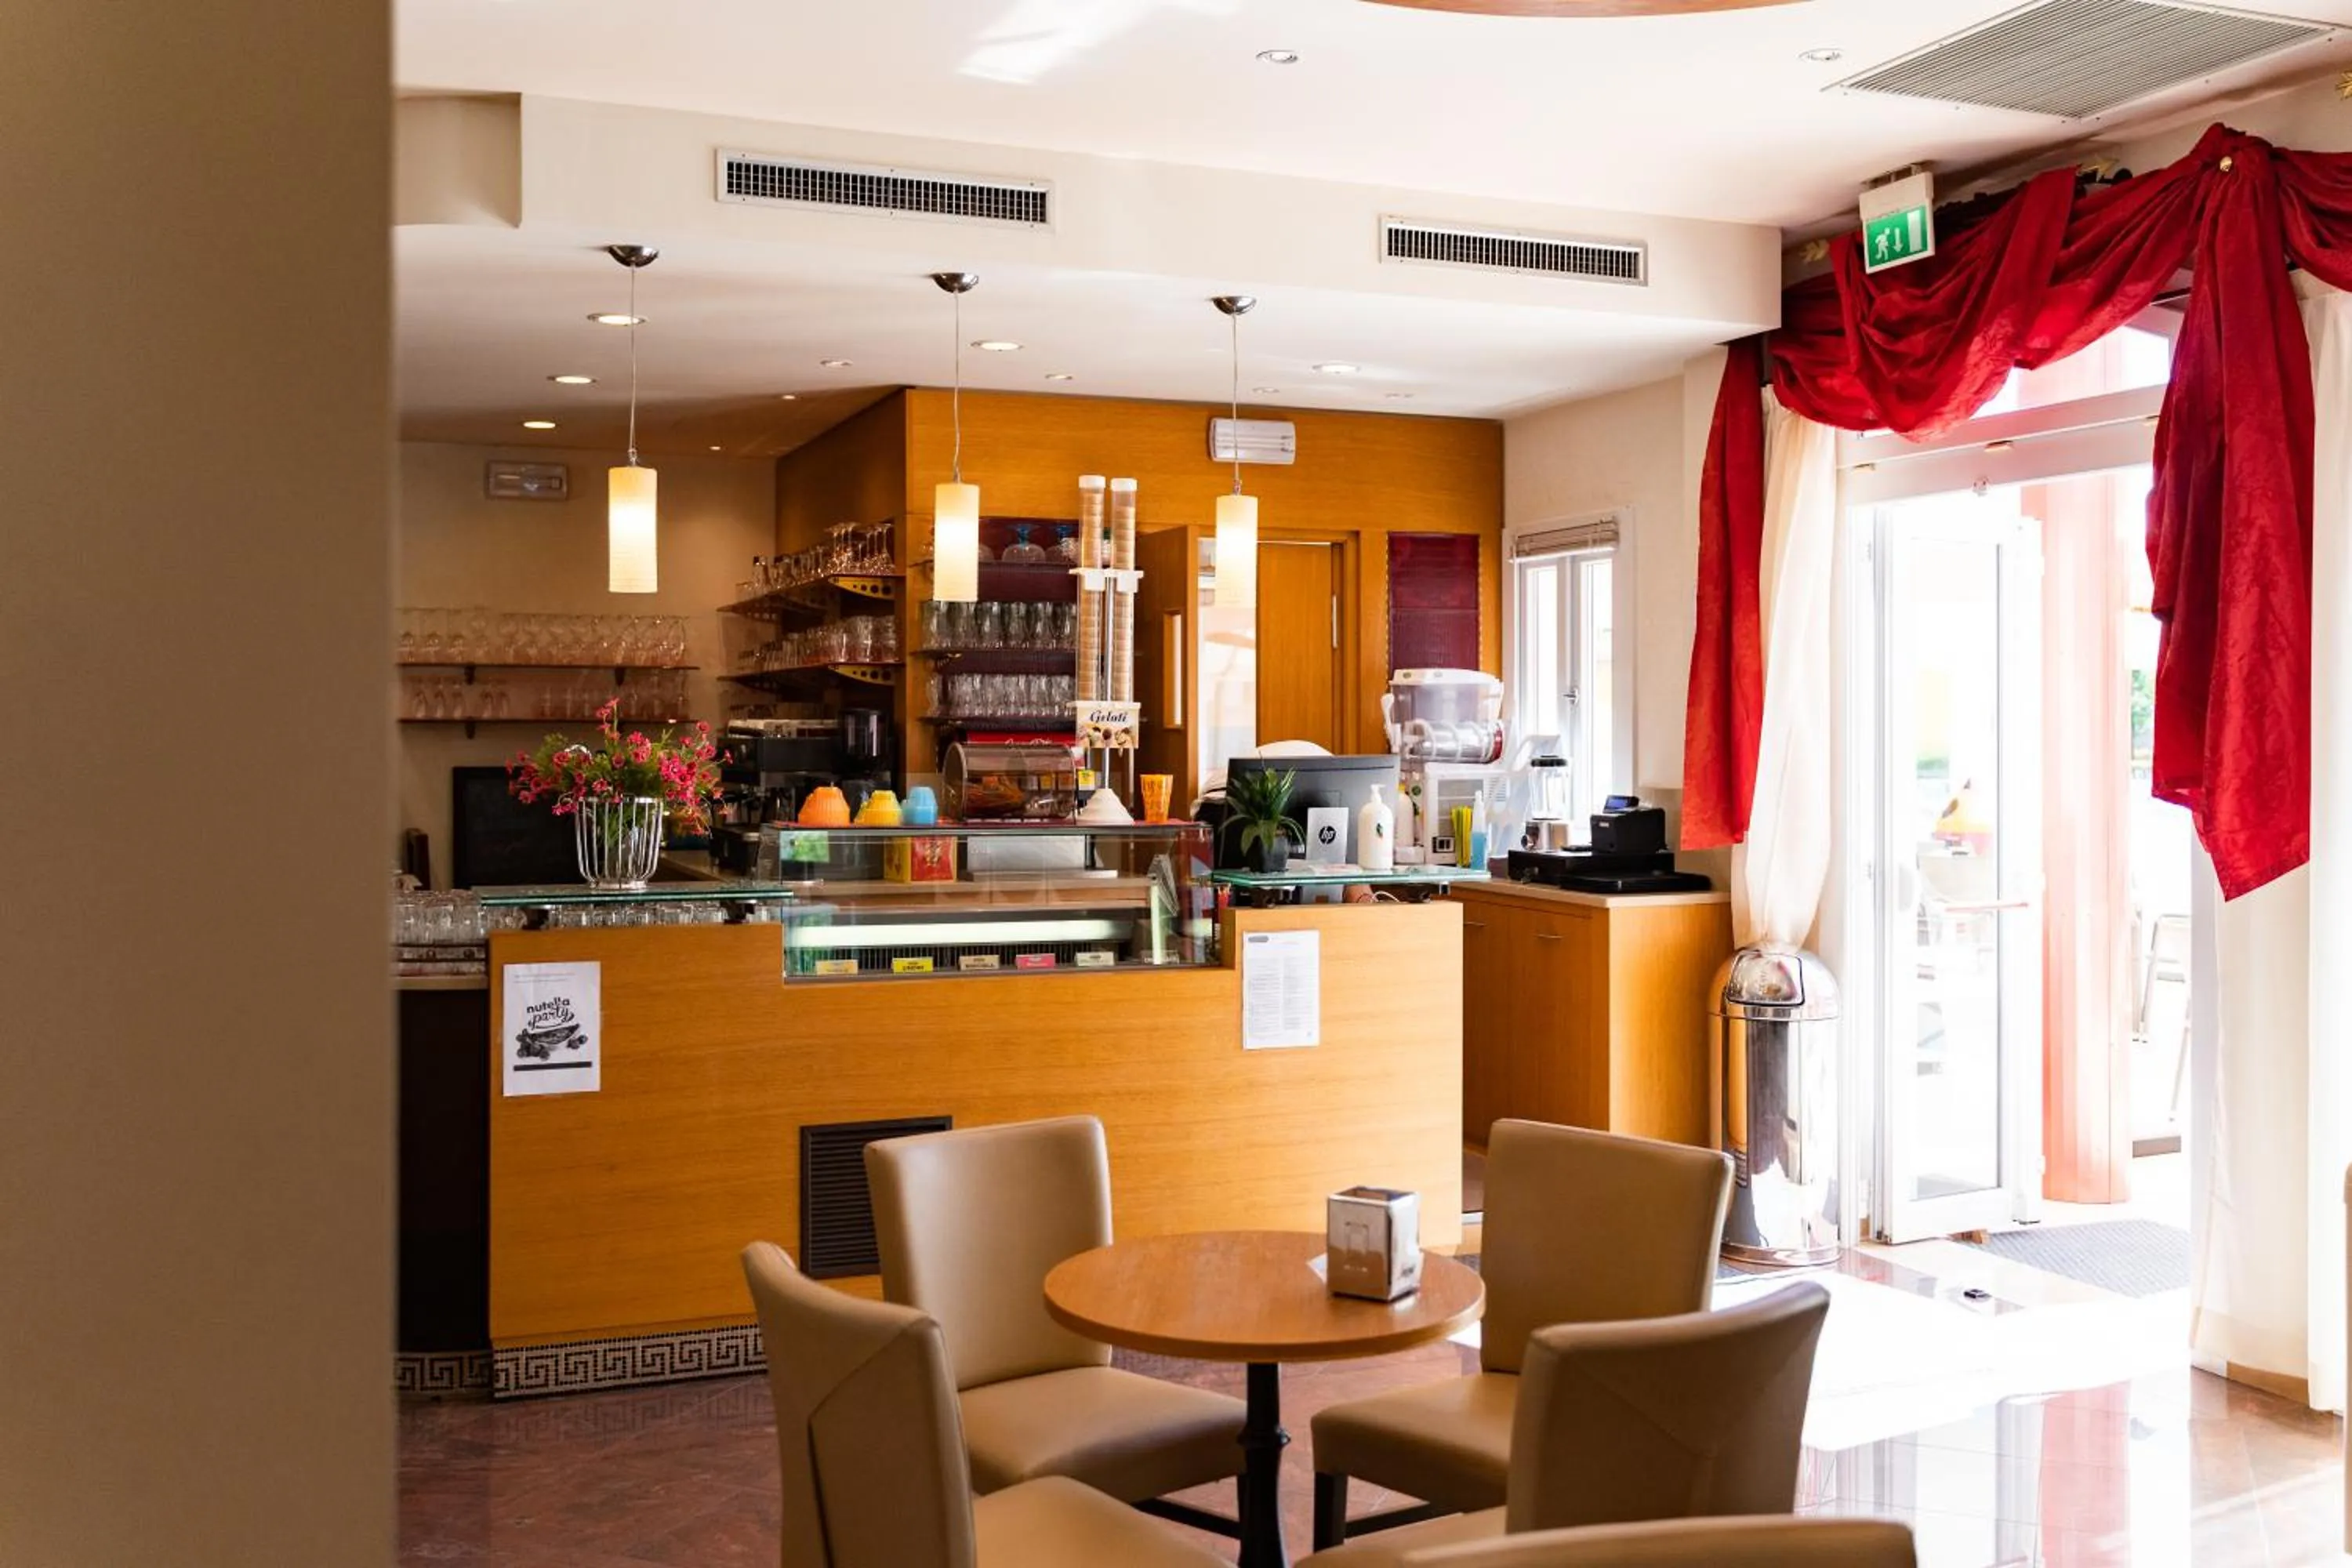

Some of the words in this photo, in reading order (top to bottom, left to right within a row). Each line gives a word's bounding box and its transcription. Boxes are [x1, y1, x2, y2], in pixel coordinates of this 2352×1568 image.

[1091, 710, 1127, 723] Gelati
[1320, 826, 1335, 844] hp
[527, 997, 571, 1014] nutella
[528, 1007, 575, 1031] party
